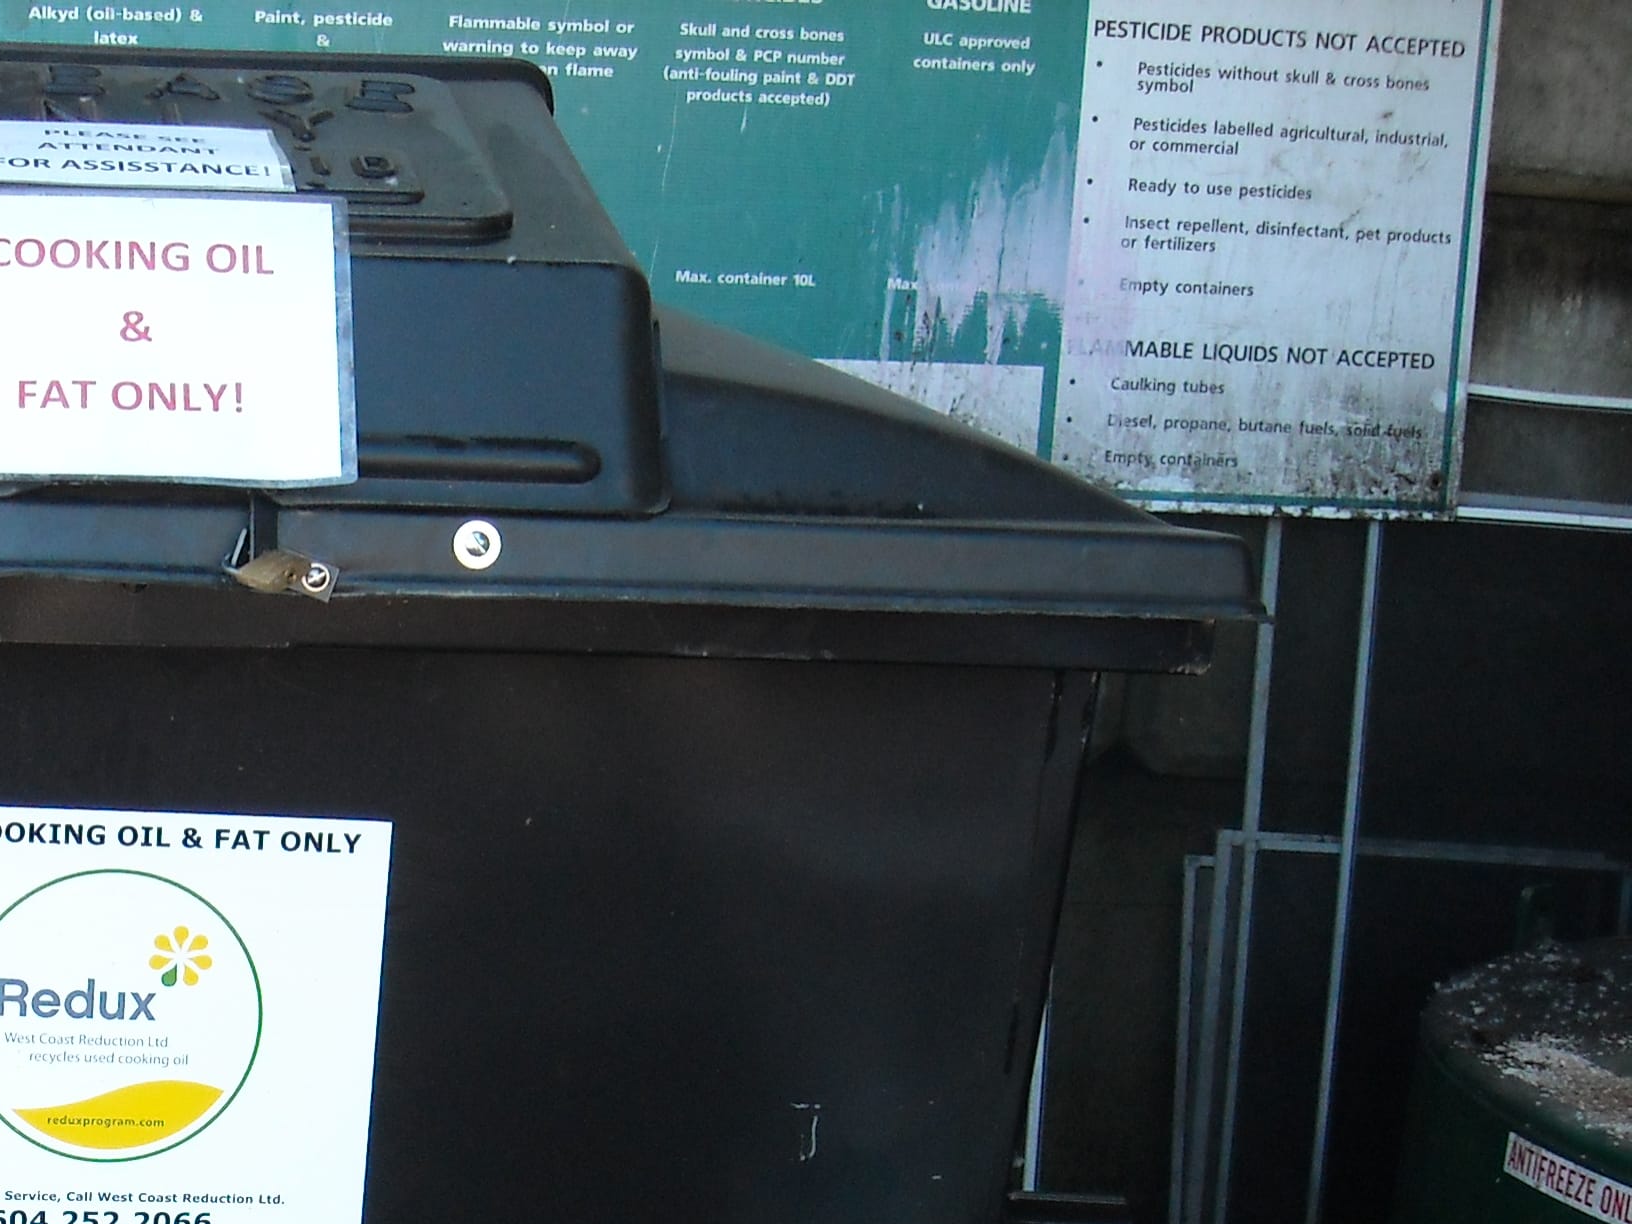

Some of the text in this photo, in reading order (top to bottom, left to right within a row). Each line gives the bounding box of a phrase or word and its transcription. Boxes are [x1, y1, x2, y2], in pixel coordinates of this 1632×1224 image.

[28, 7, 202, 24] Alkyd (oil-based) &
[927, 0, 1031, 13] GASOLINE
[255, 10, 393, 27] Paint, pesticide
[449, 15, 635, 35] Flammable symbol or
[94, 31, 138, 45] latex
[317, 34, 329, 47] &
[680, 23, 844, 42] Skull and cross bones
[924, 32, 1031, 50] ULC approved
[1093, 19, 1466, 59] PESTICIDE PRODUCTS NOT ACCEPTED
[443, 39, 637, 60] warning to keep away
[675, 48, 845, 65] symbol & PCP number
[565, 63, 614, 77] flame
[663, 65, 855, 86] (anti-fouling paint & DDT
[913, 57, 1035, 76] containers only
[1137, 61, 1430, 91] Pesticides without skull & cross bones
[1137, 77, 1194, 96] symbol
[686, 89, 830, 107] products accepted)
[1133, 118, 1449, 148] Pesticides labelled agricultural, industrial,
[37, 141, 220, 155] ATTENDANT
[1129, 138, 1239, 155] or commercial
[60, 157, 271, 177] ASSISSTANCE!
[1128, 178, 1312, 201] Ready to use pesticides
[1124, 216, 1452, 247] Insect repellent, disinfectant, pet products
[1121, 234, 1216, 252] or fertilizers
[205, 243, 276, 276] OIL
[676, 270, 816, 287] Max. container 10L
[1120, 278, 1254, 297] Empty containers
[119, 310, 153, 344] &
[1202, 341, 1279, 365] LIQUIDS
[1286, 344, 1328, 365] NOT
[1336, 348, 1435, 370] ACCEPTED
[1111, 377, 1225, 396] Caulking tubes
[18, 379, 245, 414] FAT ONLY!
[1108, 414, 1157, 433] Diesel,
[1164, 416, 1232, 436] propane,
[1238, 418, 1293, 435] butane
[1299, 420, 1338, 437] fuels,
[1104, 450, 1238, 469] Empty containers
[116, 826, 171, 849] OIL
[181, 828, 204, 849] &
[214, 828, 270, 852] FAT
[280, 830, 362, 855] ONLY
[4, 1032, 168, 1048] West Coast Reduction Ltd
[29, 1051, 189, 1069] recycles used cooking oil
[47, 1114, 165, 1130] reduxprogram.com
[1507, 1141, 1595, 1207] ANTIFREEZE
[5, 1191, 61, 1204] Service,
[66, 1191, 93, 1203] Call
[97, 1192, 133, 1204] West
[138, 1193, 178, 1205] Coast
[182, 1193, 254, 1206] Reduction
[259, 1194, 285, 1206] Ltd.
